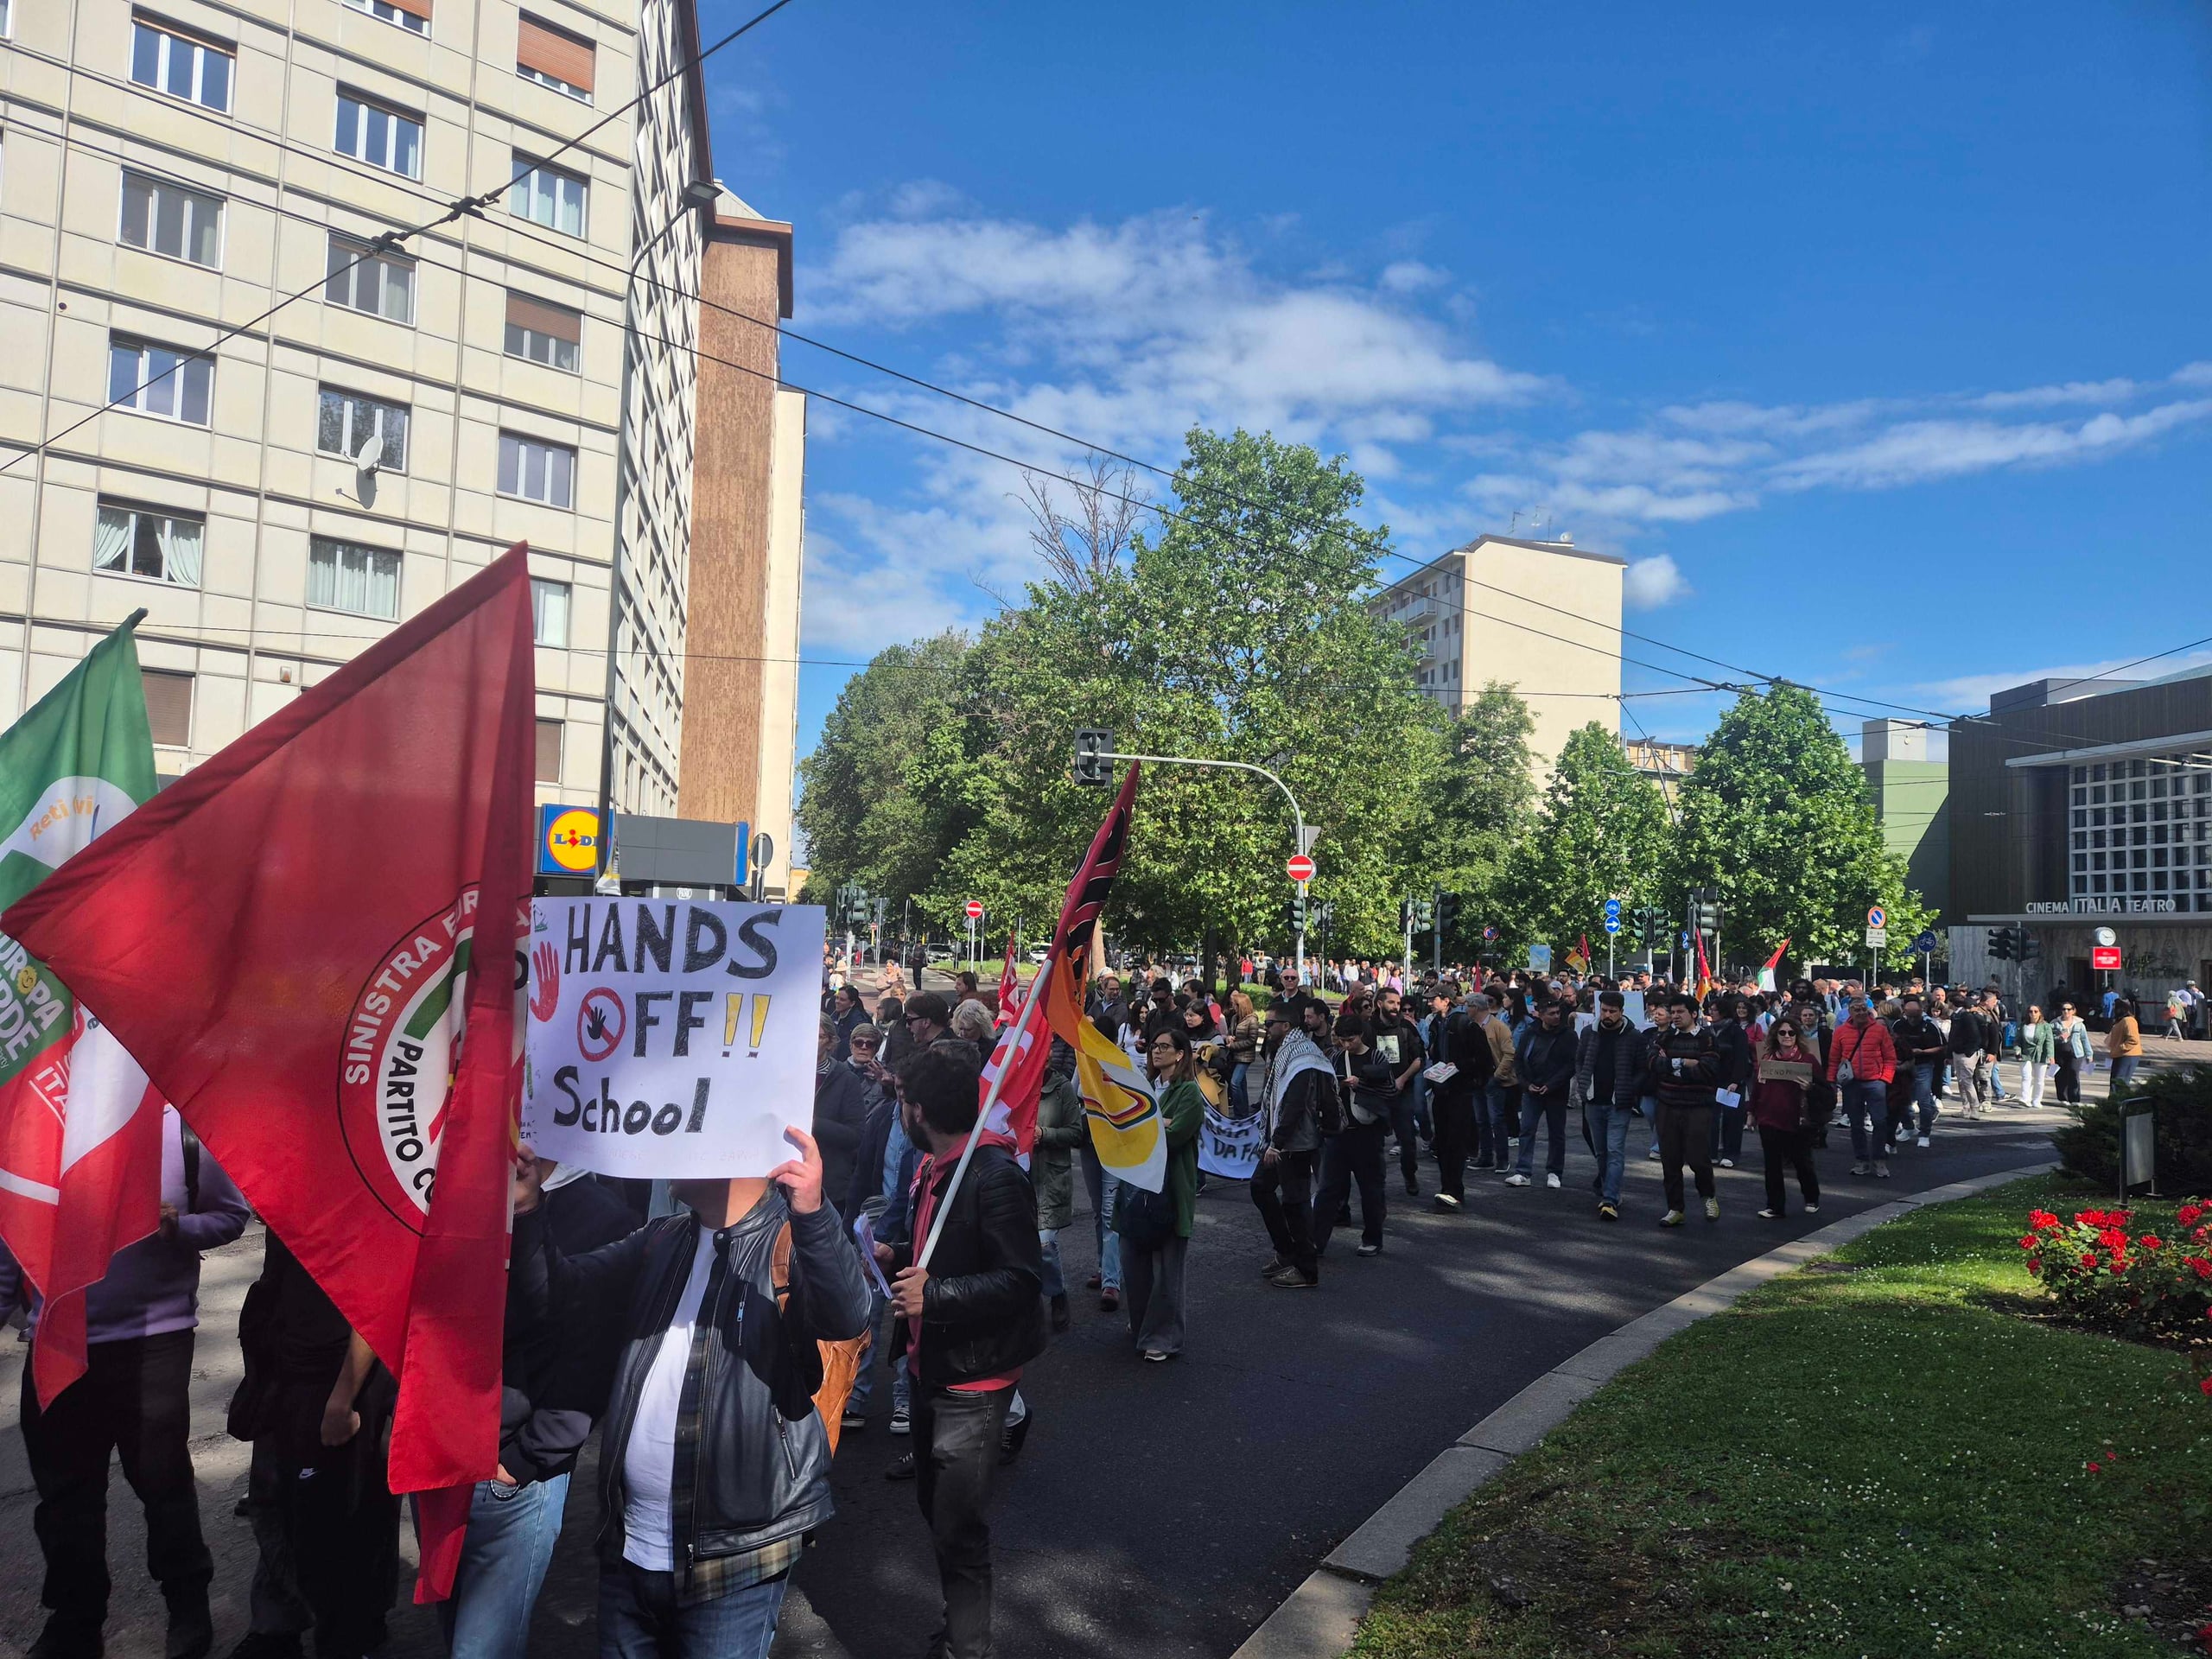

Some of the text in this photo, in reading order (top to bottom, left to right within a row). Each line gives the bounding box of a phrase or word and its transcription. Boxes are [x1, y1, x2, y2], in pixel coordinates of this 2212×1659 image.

[564, 902, 783, 979] HANDS
[2025, 898, 2177, 914] CINEMA ITALIA TEATRO
[346, 936, 442, 1085] SINISTRA
[386, 1040, 423, 1161] PARTITO
[553, 1065, 711, 1136] School
[1214, 1136, 1236, 1159] DA
[1241, 1141, 1260, 1162] FA
